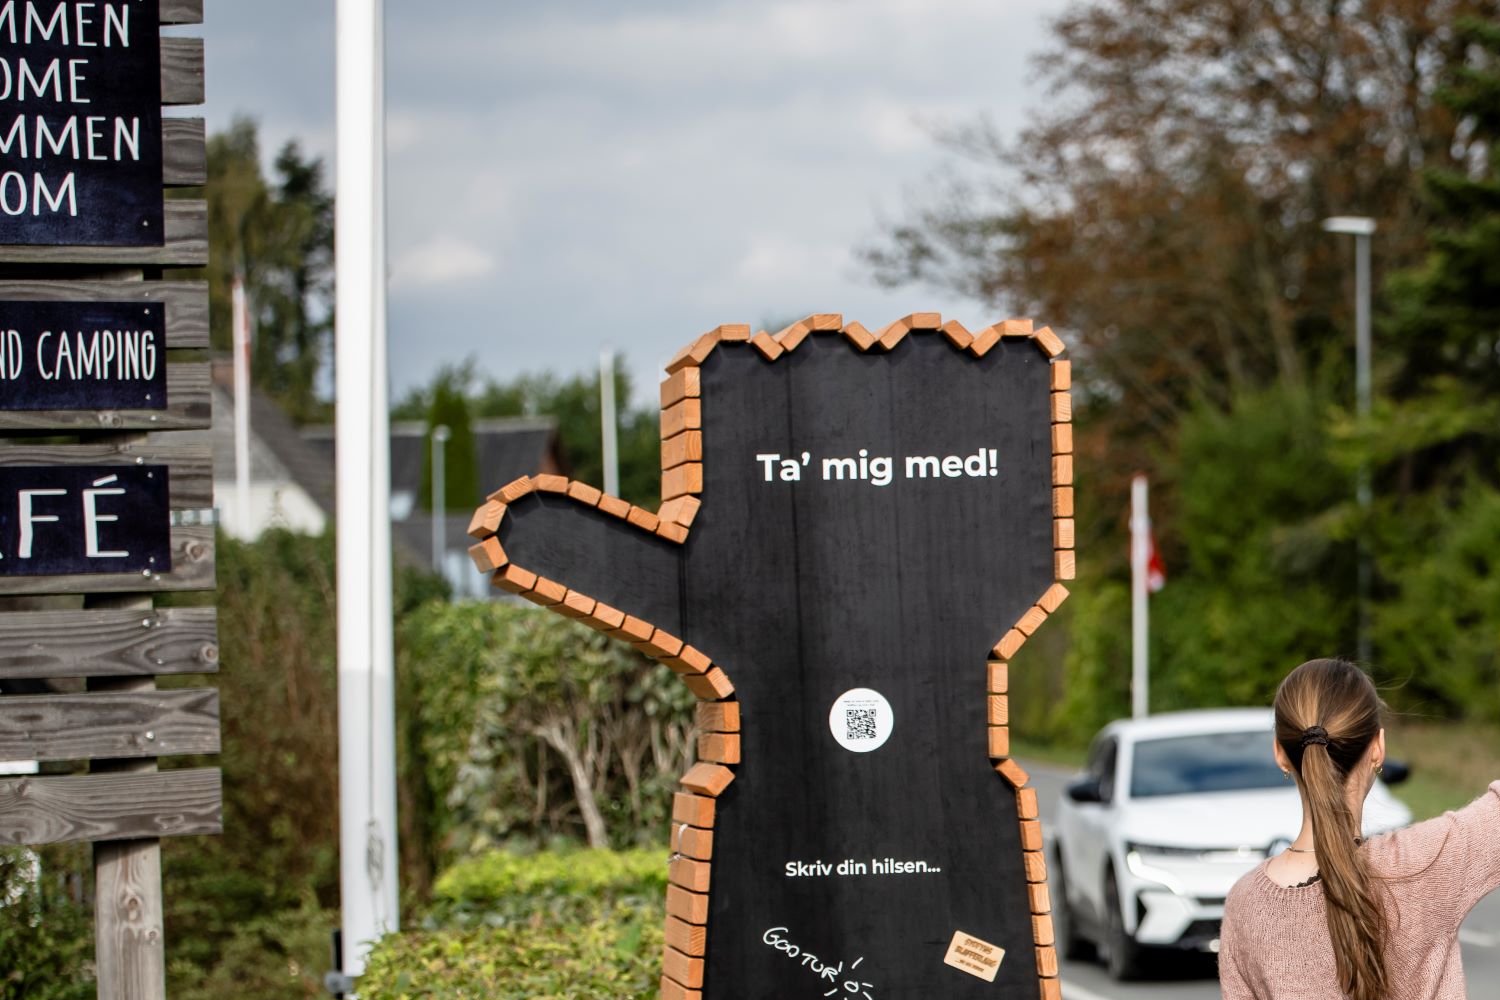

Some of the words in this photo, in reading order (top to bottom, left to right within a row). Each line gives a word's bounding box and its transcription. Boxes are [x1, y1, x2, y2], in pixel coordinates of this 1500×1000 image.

[37, 330, 156, 380] CAMPING
[822, 449, 893, 487] mig
[905, 447, 998, 478] med!
[0, 474, 129, 558] FÉ
[785, 860, 832, 876] Skriv
[836, 859, 867, 875] din
[871, 857, 941, 875] hilsen...
[763, 927, 800, 958] GOD
